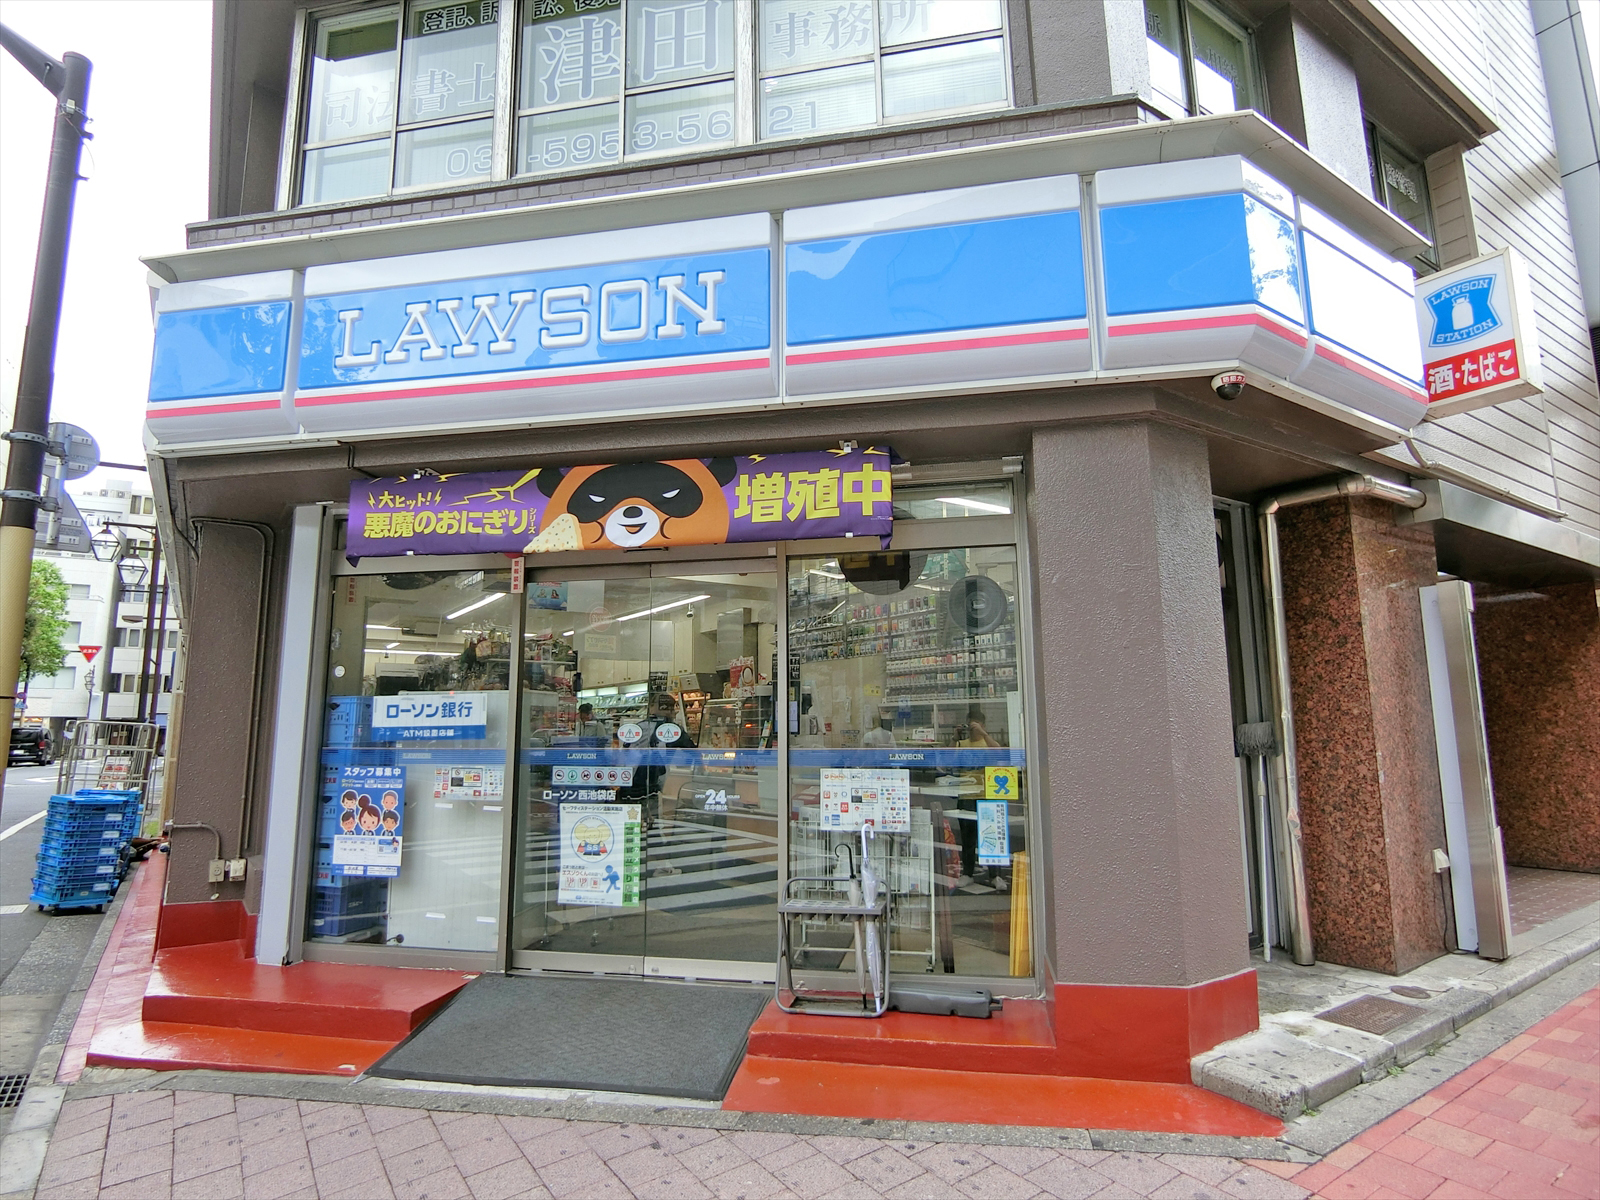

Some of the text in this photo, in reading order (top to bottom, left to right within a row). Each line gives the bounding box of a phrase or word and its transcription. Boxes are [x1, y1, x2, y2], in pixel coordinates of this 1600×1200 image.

[324, 0, 934, 130] 司法書士 津田 事務所
[1431, 278, 1490, 306] LAWSON
[334, 270, 726, 368] LAWSON
[1436, 318, 1494, 343] STATION
[1427, 349, 1515, 394] 酒・たばこ
[733, 462, 893, 523] 増殖中
[363, 508, 528, 539] 悪魔のおにぎり
[386, 701, 473, 719] ローソン銀行
[543, 789, 617, 801] ローソン西池袋店
[705, 788, 727, 805] 24
